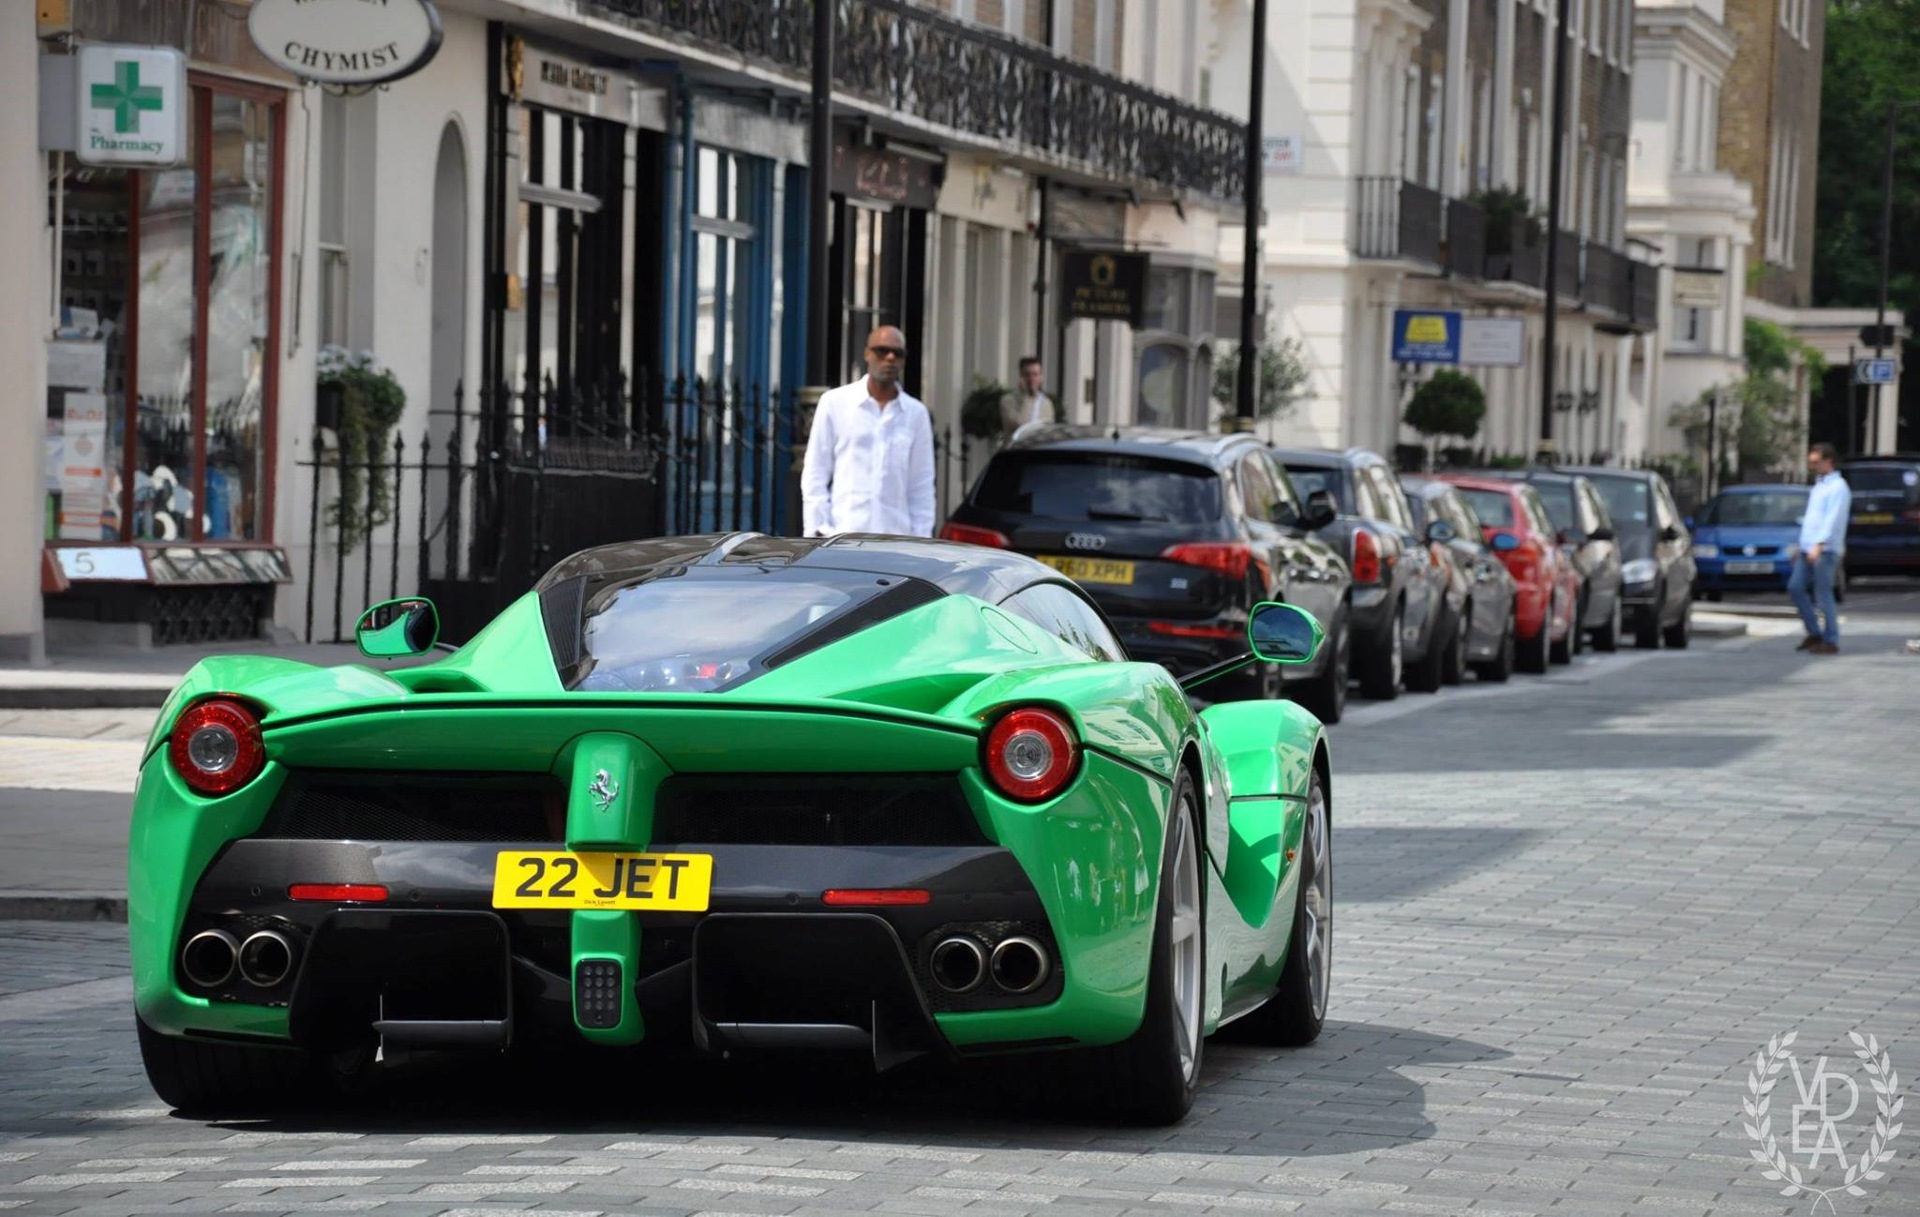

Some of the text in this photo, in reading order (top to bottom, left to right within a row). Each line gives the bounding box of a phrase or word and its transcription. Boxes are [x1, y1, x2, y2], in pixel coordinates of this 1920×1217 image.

[284, 41, 398, 70] CHYMIST
[91, 135, 164, 154] Pharmacy
[76, 552, 94, 574] 5
[1094, 561, 1126, 579] XPH
[515, 857, 690, 899] 22 JET
